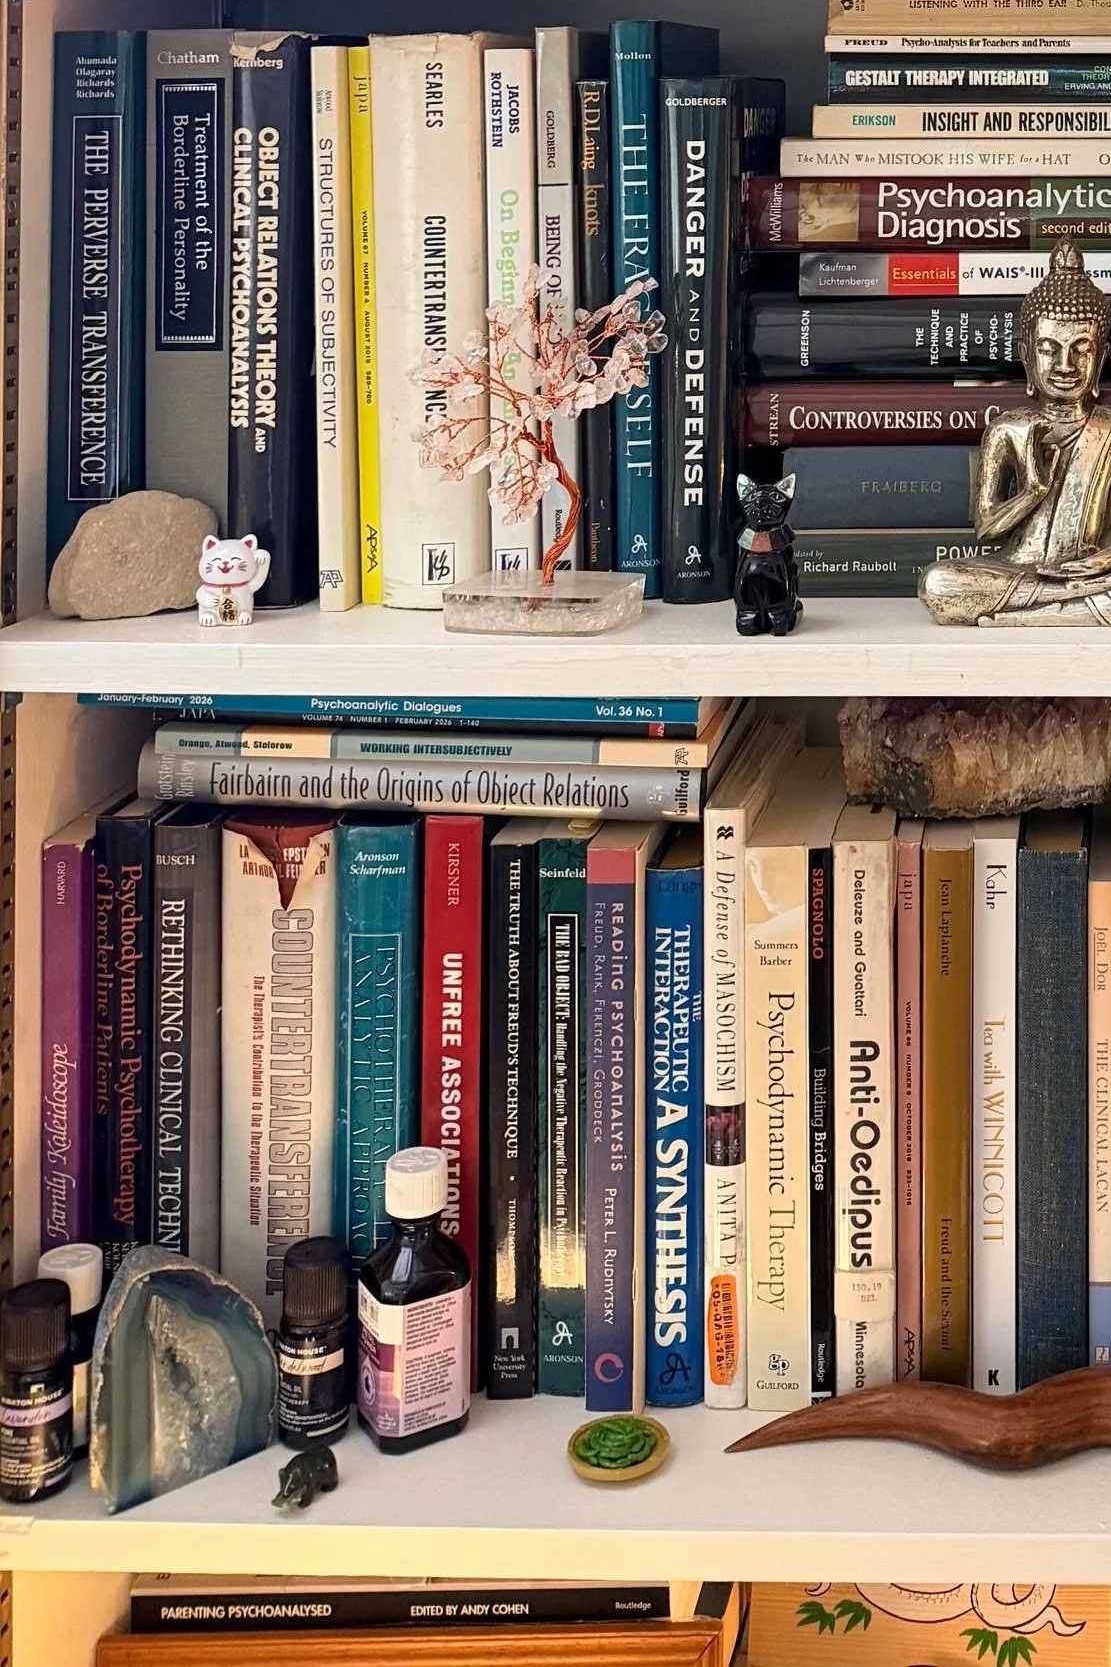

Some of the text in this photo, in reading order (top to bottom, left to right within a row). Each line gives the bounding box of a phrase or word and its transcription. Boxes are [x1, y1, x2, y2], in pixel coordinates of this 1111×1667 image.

[157, 50, 220, 66] Chatham
[845, 69, 1049, 88] GESTALT THERAPY INTEGRATED
[852, 115, 896, 126] ERIKSON
[922, 112, 979, 132] INSIGHT
[983, 111, 1014, 131] AND
[877, 213, 1021, 243] Diagnosis
[1041, 221, 1085, 234] second
[892, 266, 975, 281] Essentials of
[684, 140, 706, 507] DANGER AND DEFENSE
[310, 698, 462, 715] Psychoanalytic Dialogues
[595, 705, 663, 717] Vol. 36 No. 1
[360, 743, 513, 757] WORKING INTERSUBJECTIVELY
[209, 763, 629, 811] Fairbairn and the Origins of Object Relations
[842, 1040, 881, 1268] Anti-Oedipus
[654, 1098, 689, 1346] A SYNTHESIS
[161, 1604, 332, 1619] PARENTING PSYCHOANALYSED
[410, 1603, 529, 1616] EDITED BY ANDY COHEN
